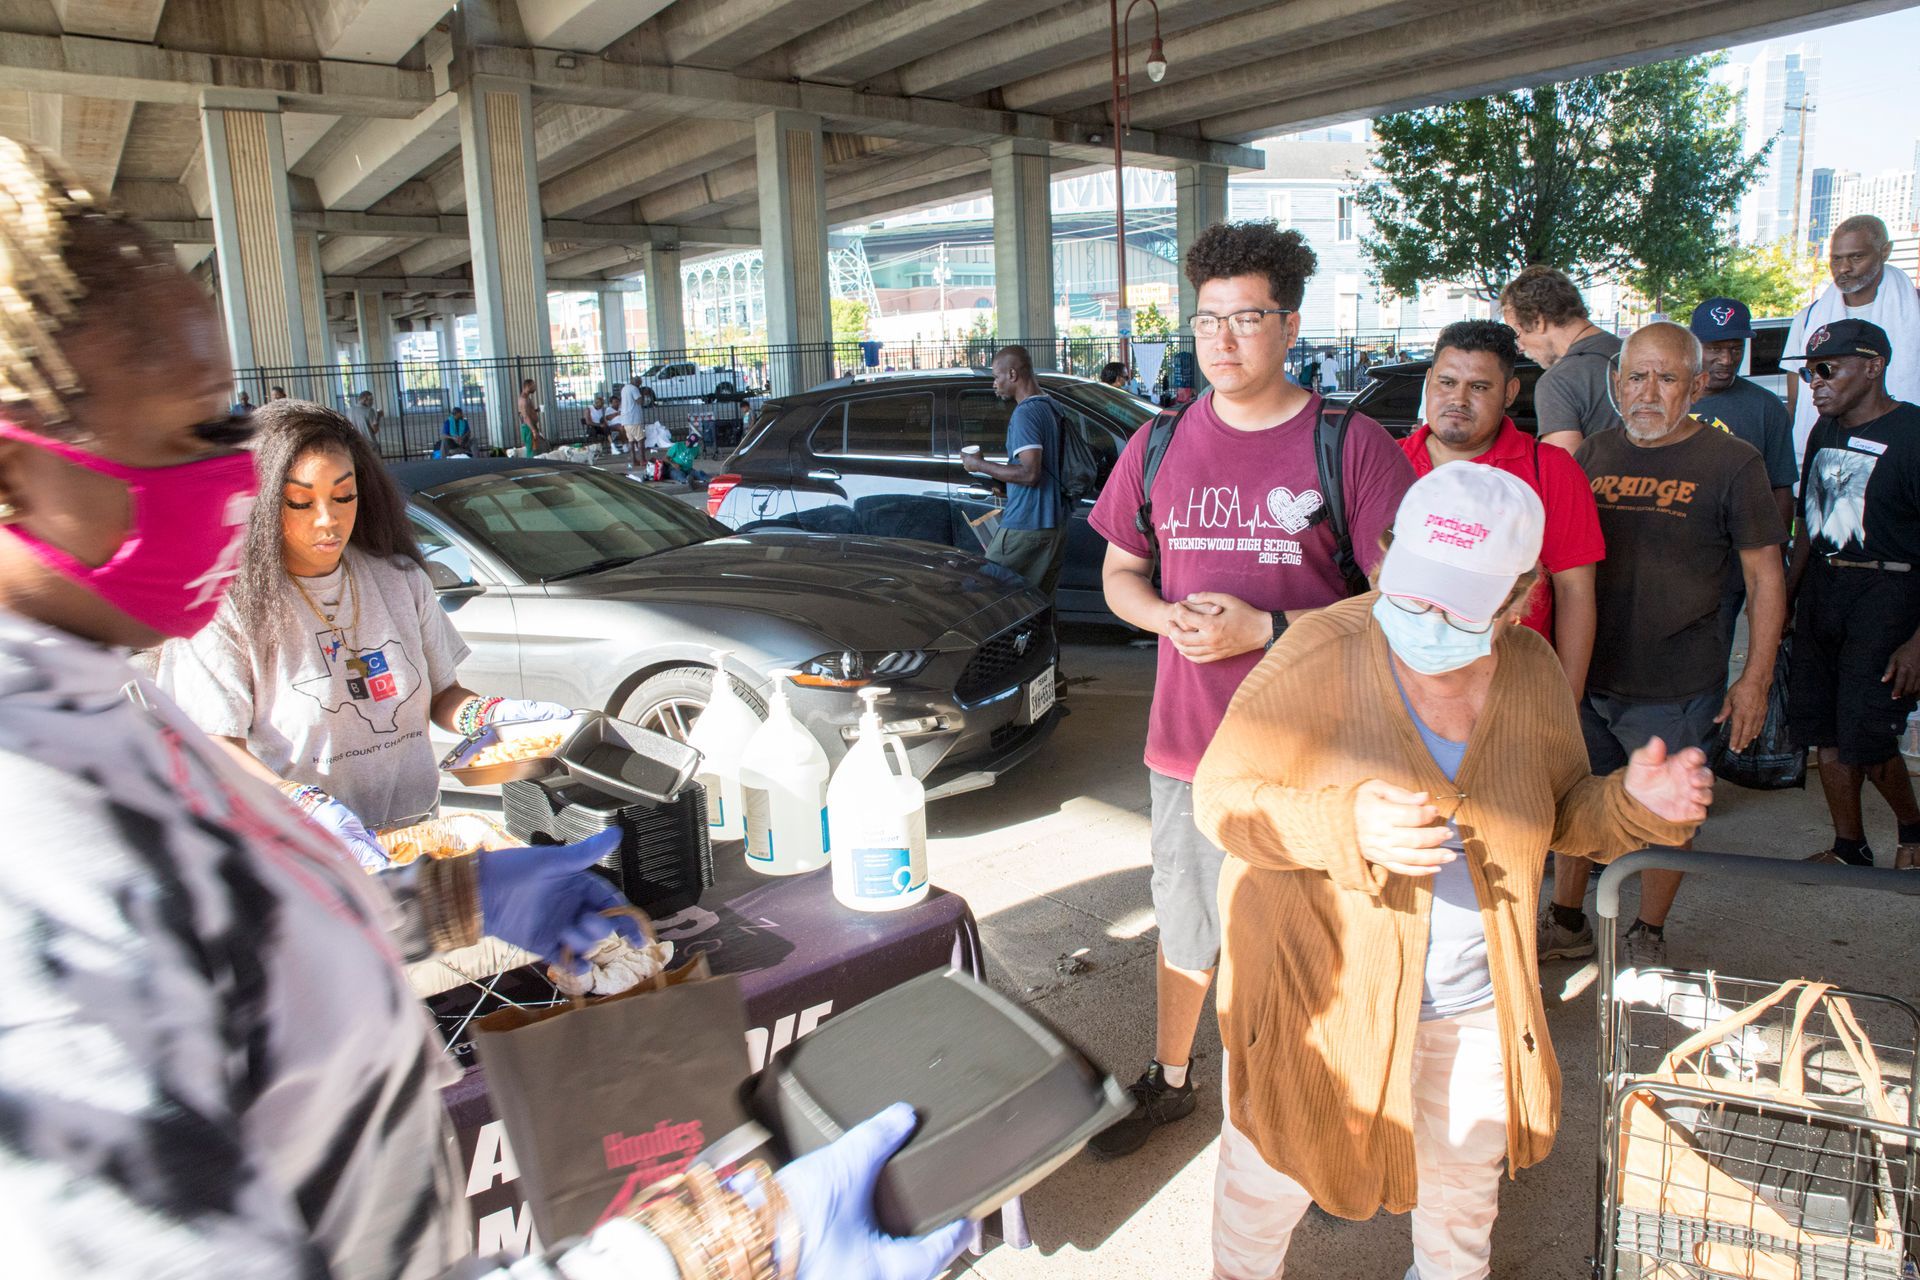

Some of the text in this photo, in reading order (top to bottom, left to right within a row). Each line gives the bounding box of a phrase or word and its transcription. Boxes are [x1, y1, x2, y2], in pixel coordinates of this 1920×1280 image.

[1591, 475, 1696, 507] ORANGE
[1186, 485, 1242, 529] HOSA
[1424, 514, 1490, 542] practically
[1428, 530, 1475, 549] perfect
[1168, 537, 1303, 554] FRIENDSWOOD HIGH SCHOOL
[1258, 552, 1303, 566] 2015-2016
[375, 679, 387, 692] D
[345, 744, 382, 758] COUNTY
[384, 731, 423, 748] CHAPTER
